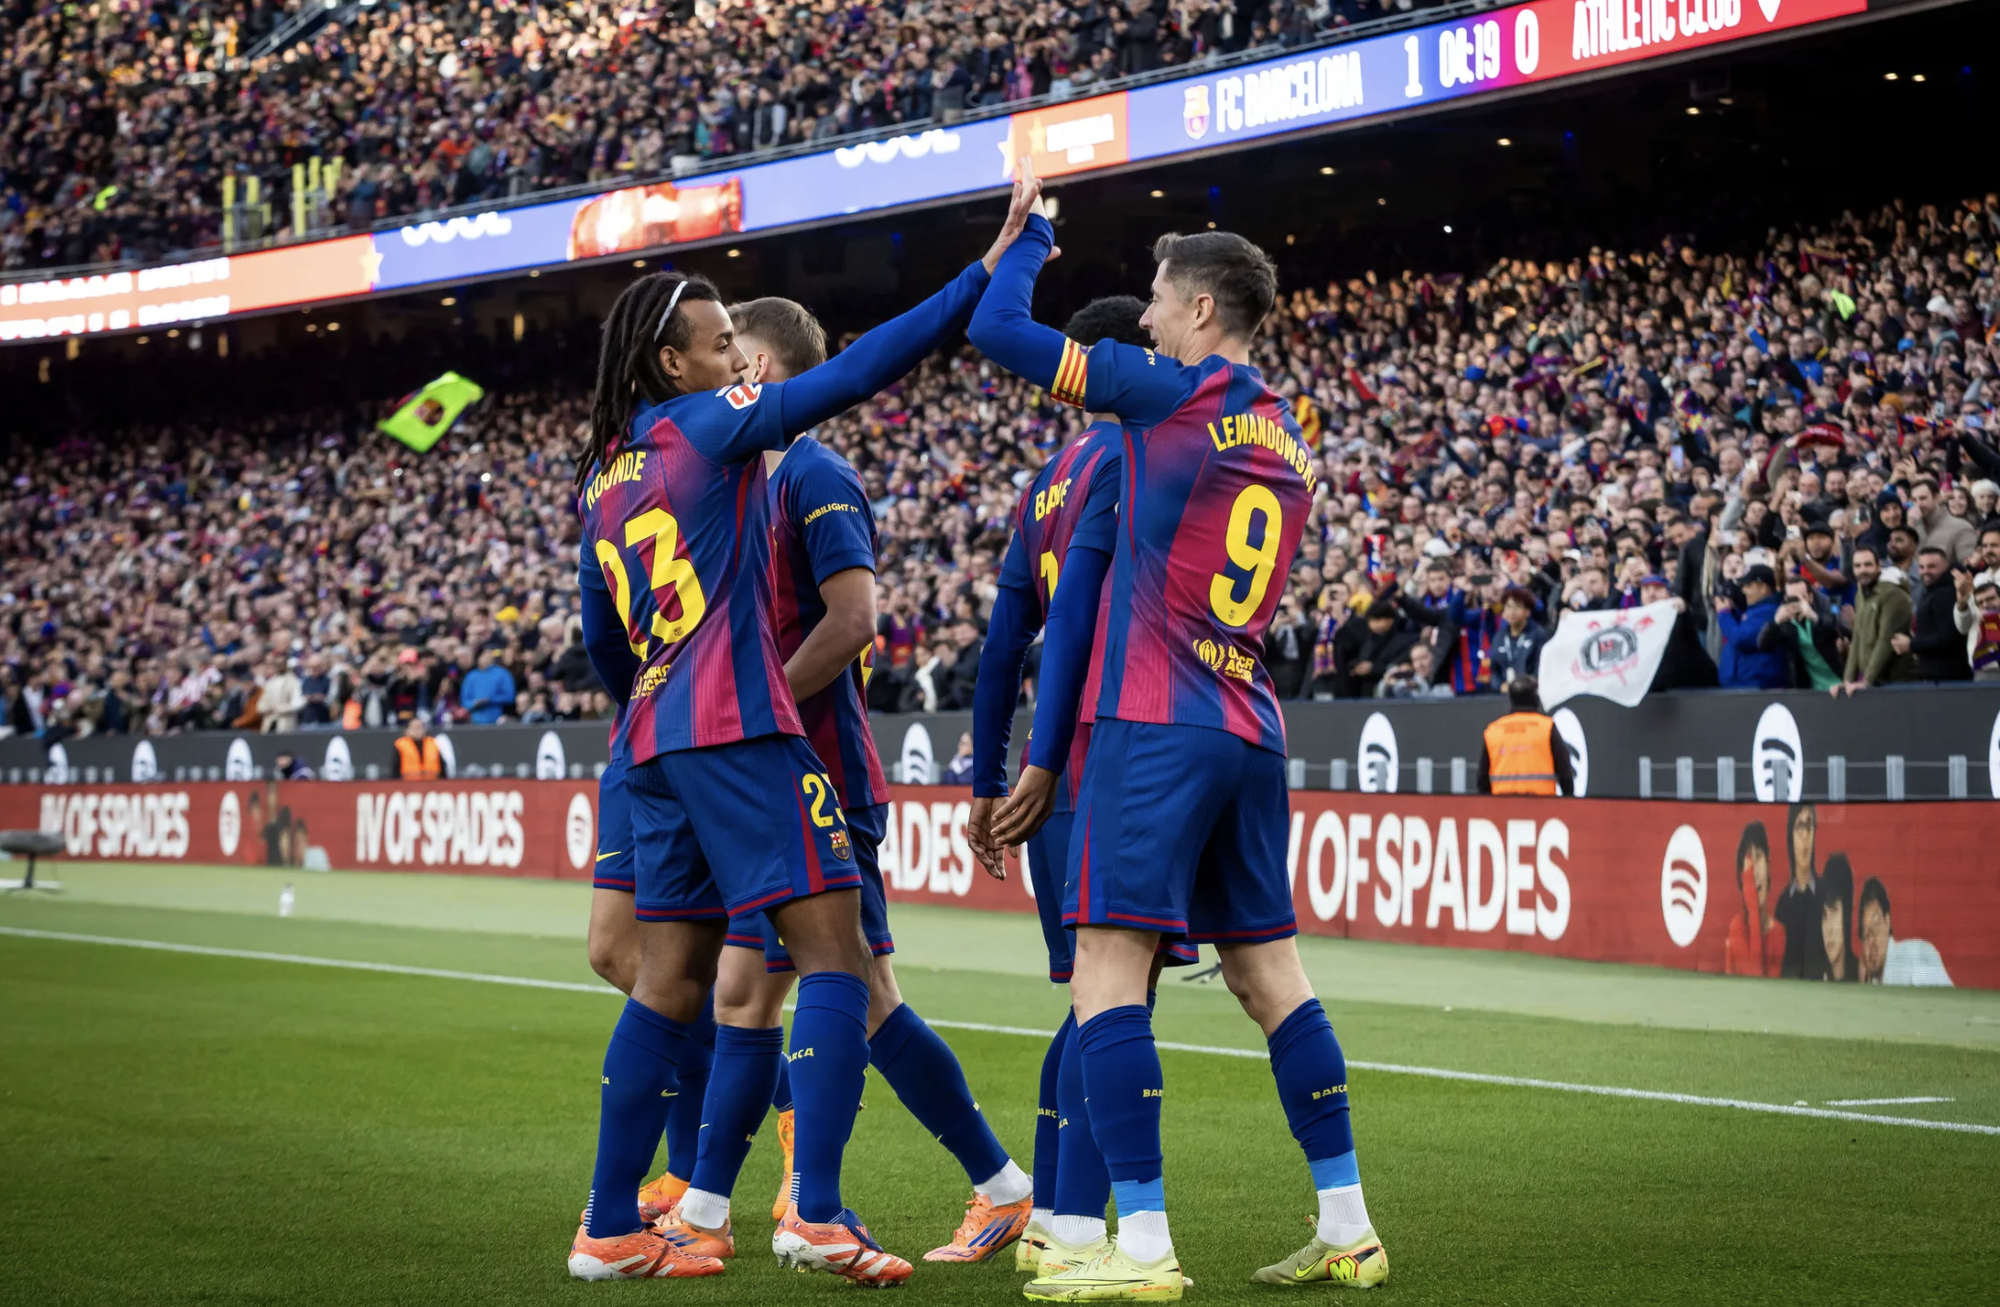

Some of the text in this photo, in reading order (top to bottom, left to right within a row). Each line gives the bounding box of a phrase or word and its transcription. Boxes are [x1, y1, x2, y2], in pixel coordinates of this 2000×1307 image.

[1404, 35, 1423, 98] 1
[1515, 9, 1539, 75] 0
[1572, 0, 1676, 60] ATHLETIC
[1216, 51, 1364, 132] FC BARCELONA
[1207, 413, 1317, 493] LEWANDOWSKI
[804, 503, 848, 525] AMBILIGHT
[595, 507, 706, 662] 23
[1209, 484, 1283, 627] 9
[65, 792, 99, 856] OF
[98, 791, 190, 858] SPADES
[384, 791, 422, 865] OF
[421, 791, 525, 868] SPADES
[877, 801, 974, 897] ADES
[1307, 810, 1372, 922] OF
[1374, 812, 1571, 941] SPADES
